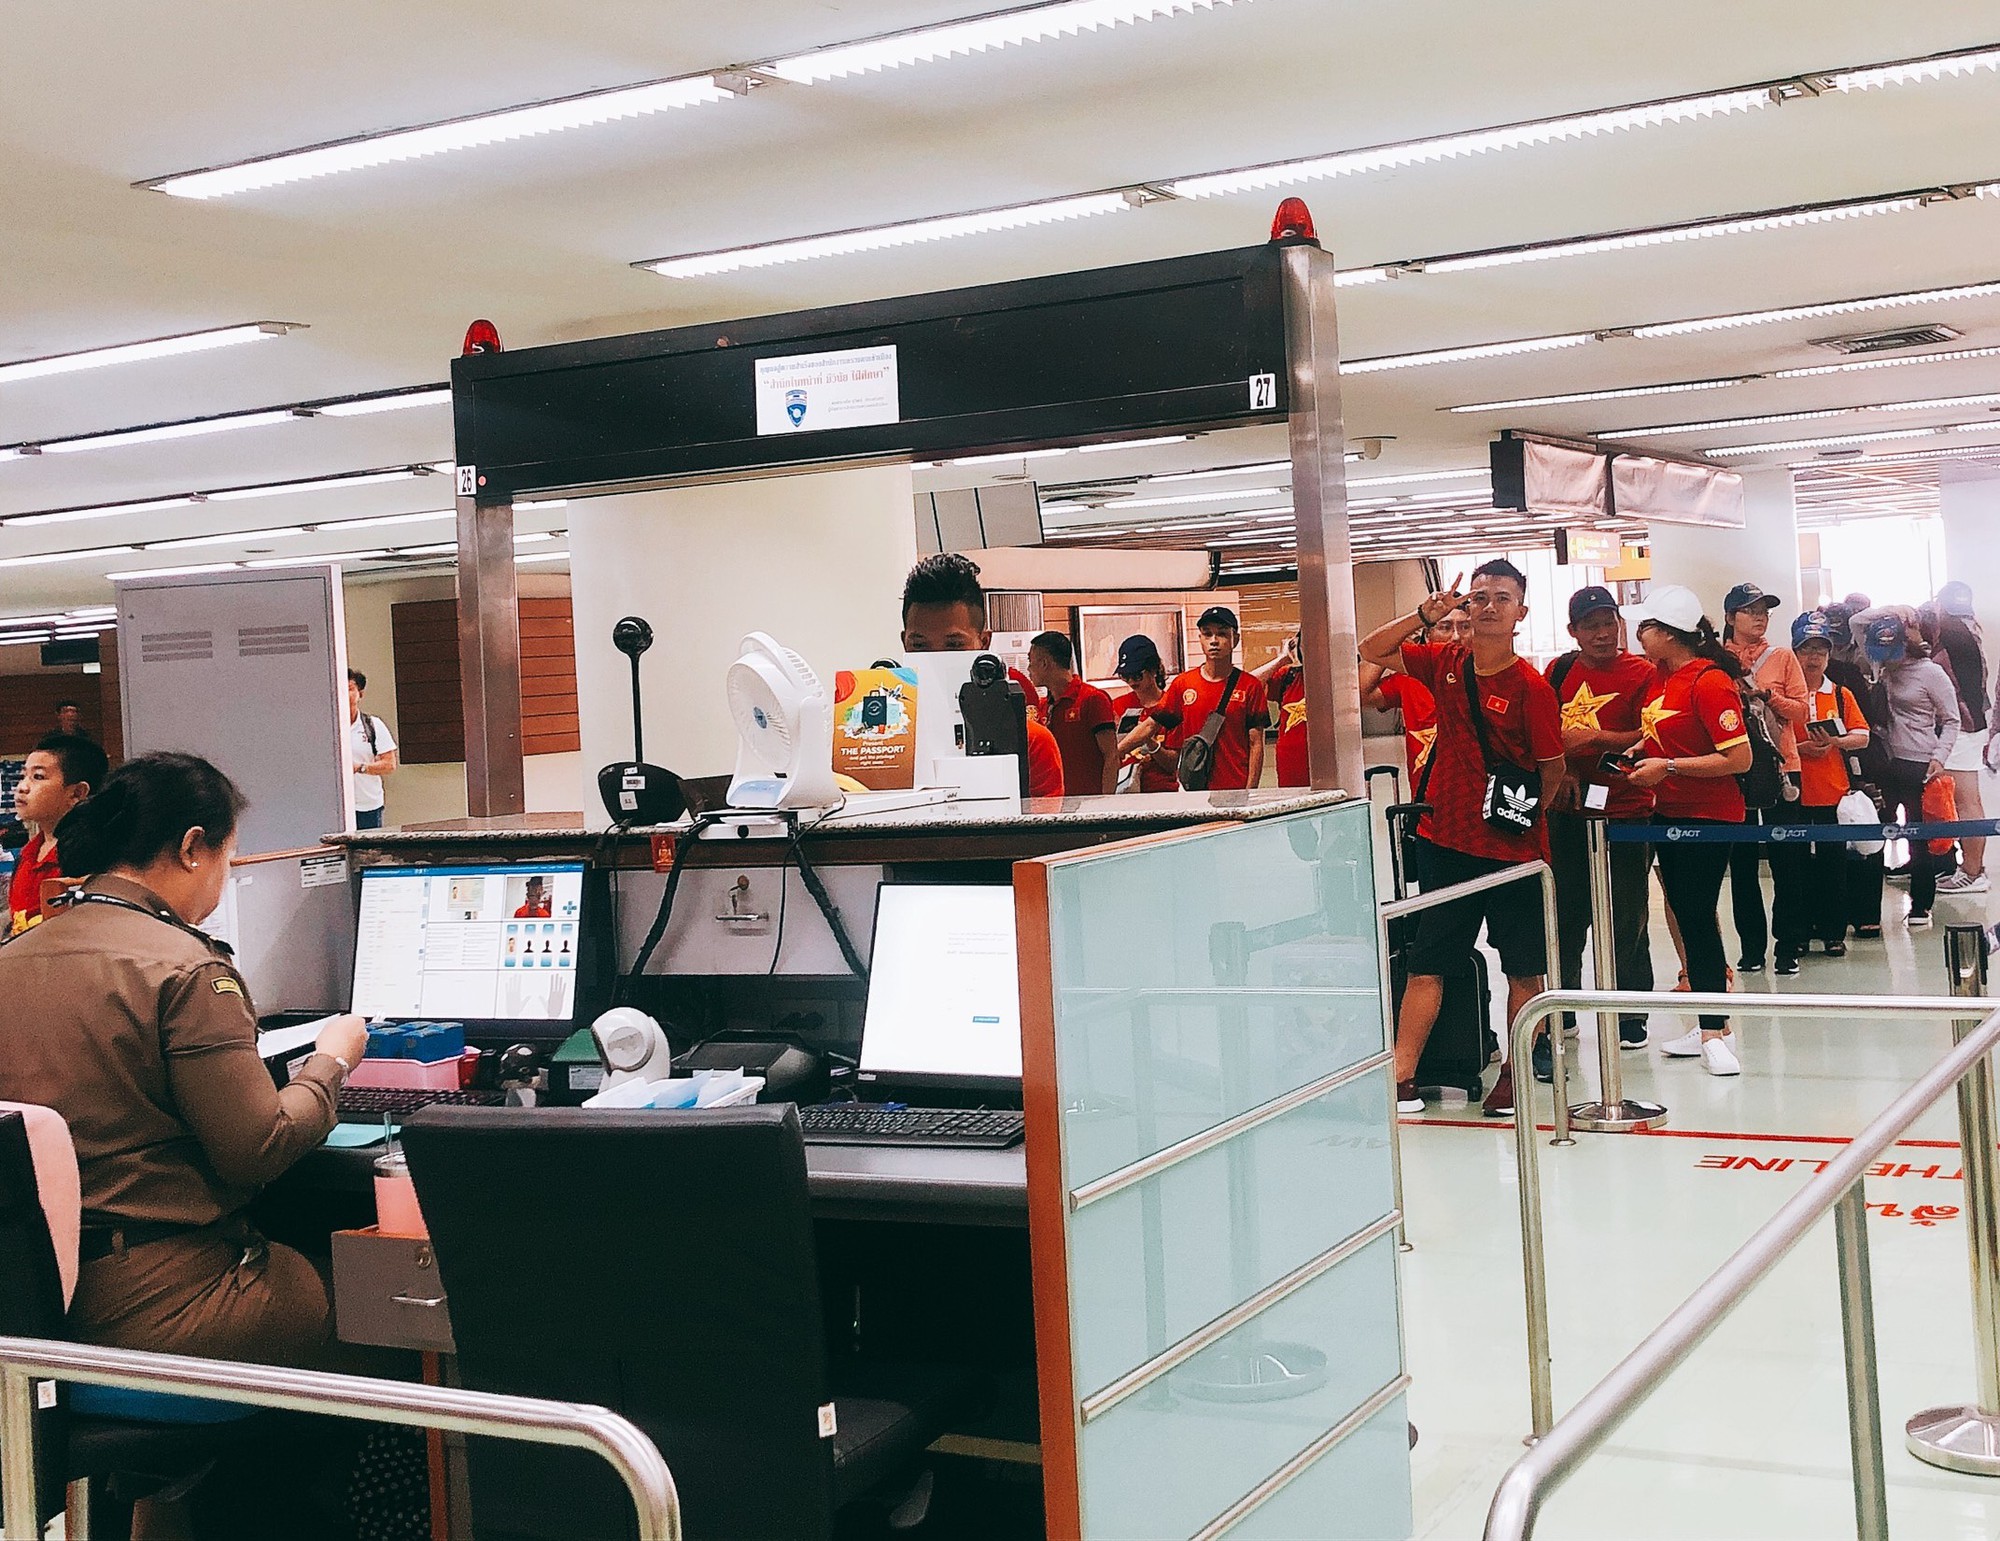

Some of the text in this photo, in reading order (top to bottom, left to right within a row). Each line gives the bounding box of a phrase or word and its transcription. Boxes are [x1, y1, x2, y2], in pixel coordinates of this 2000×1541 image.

[1256, 377, 1271, 407] 27
[461, 468, 472, 493] 26
[840, 745, 906, 756] THE PASSPORT
[1497, 807, 1532, 827] adidas
[1693, 1155, 1831, 1174] LINE
